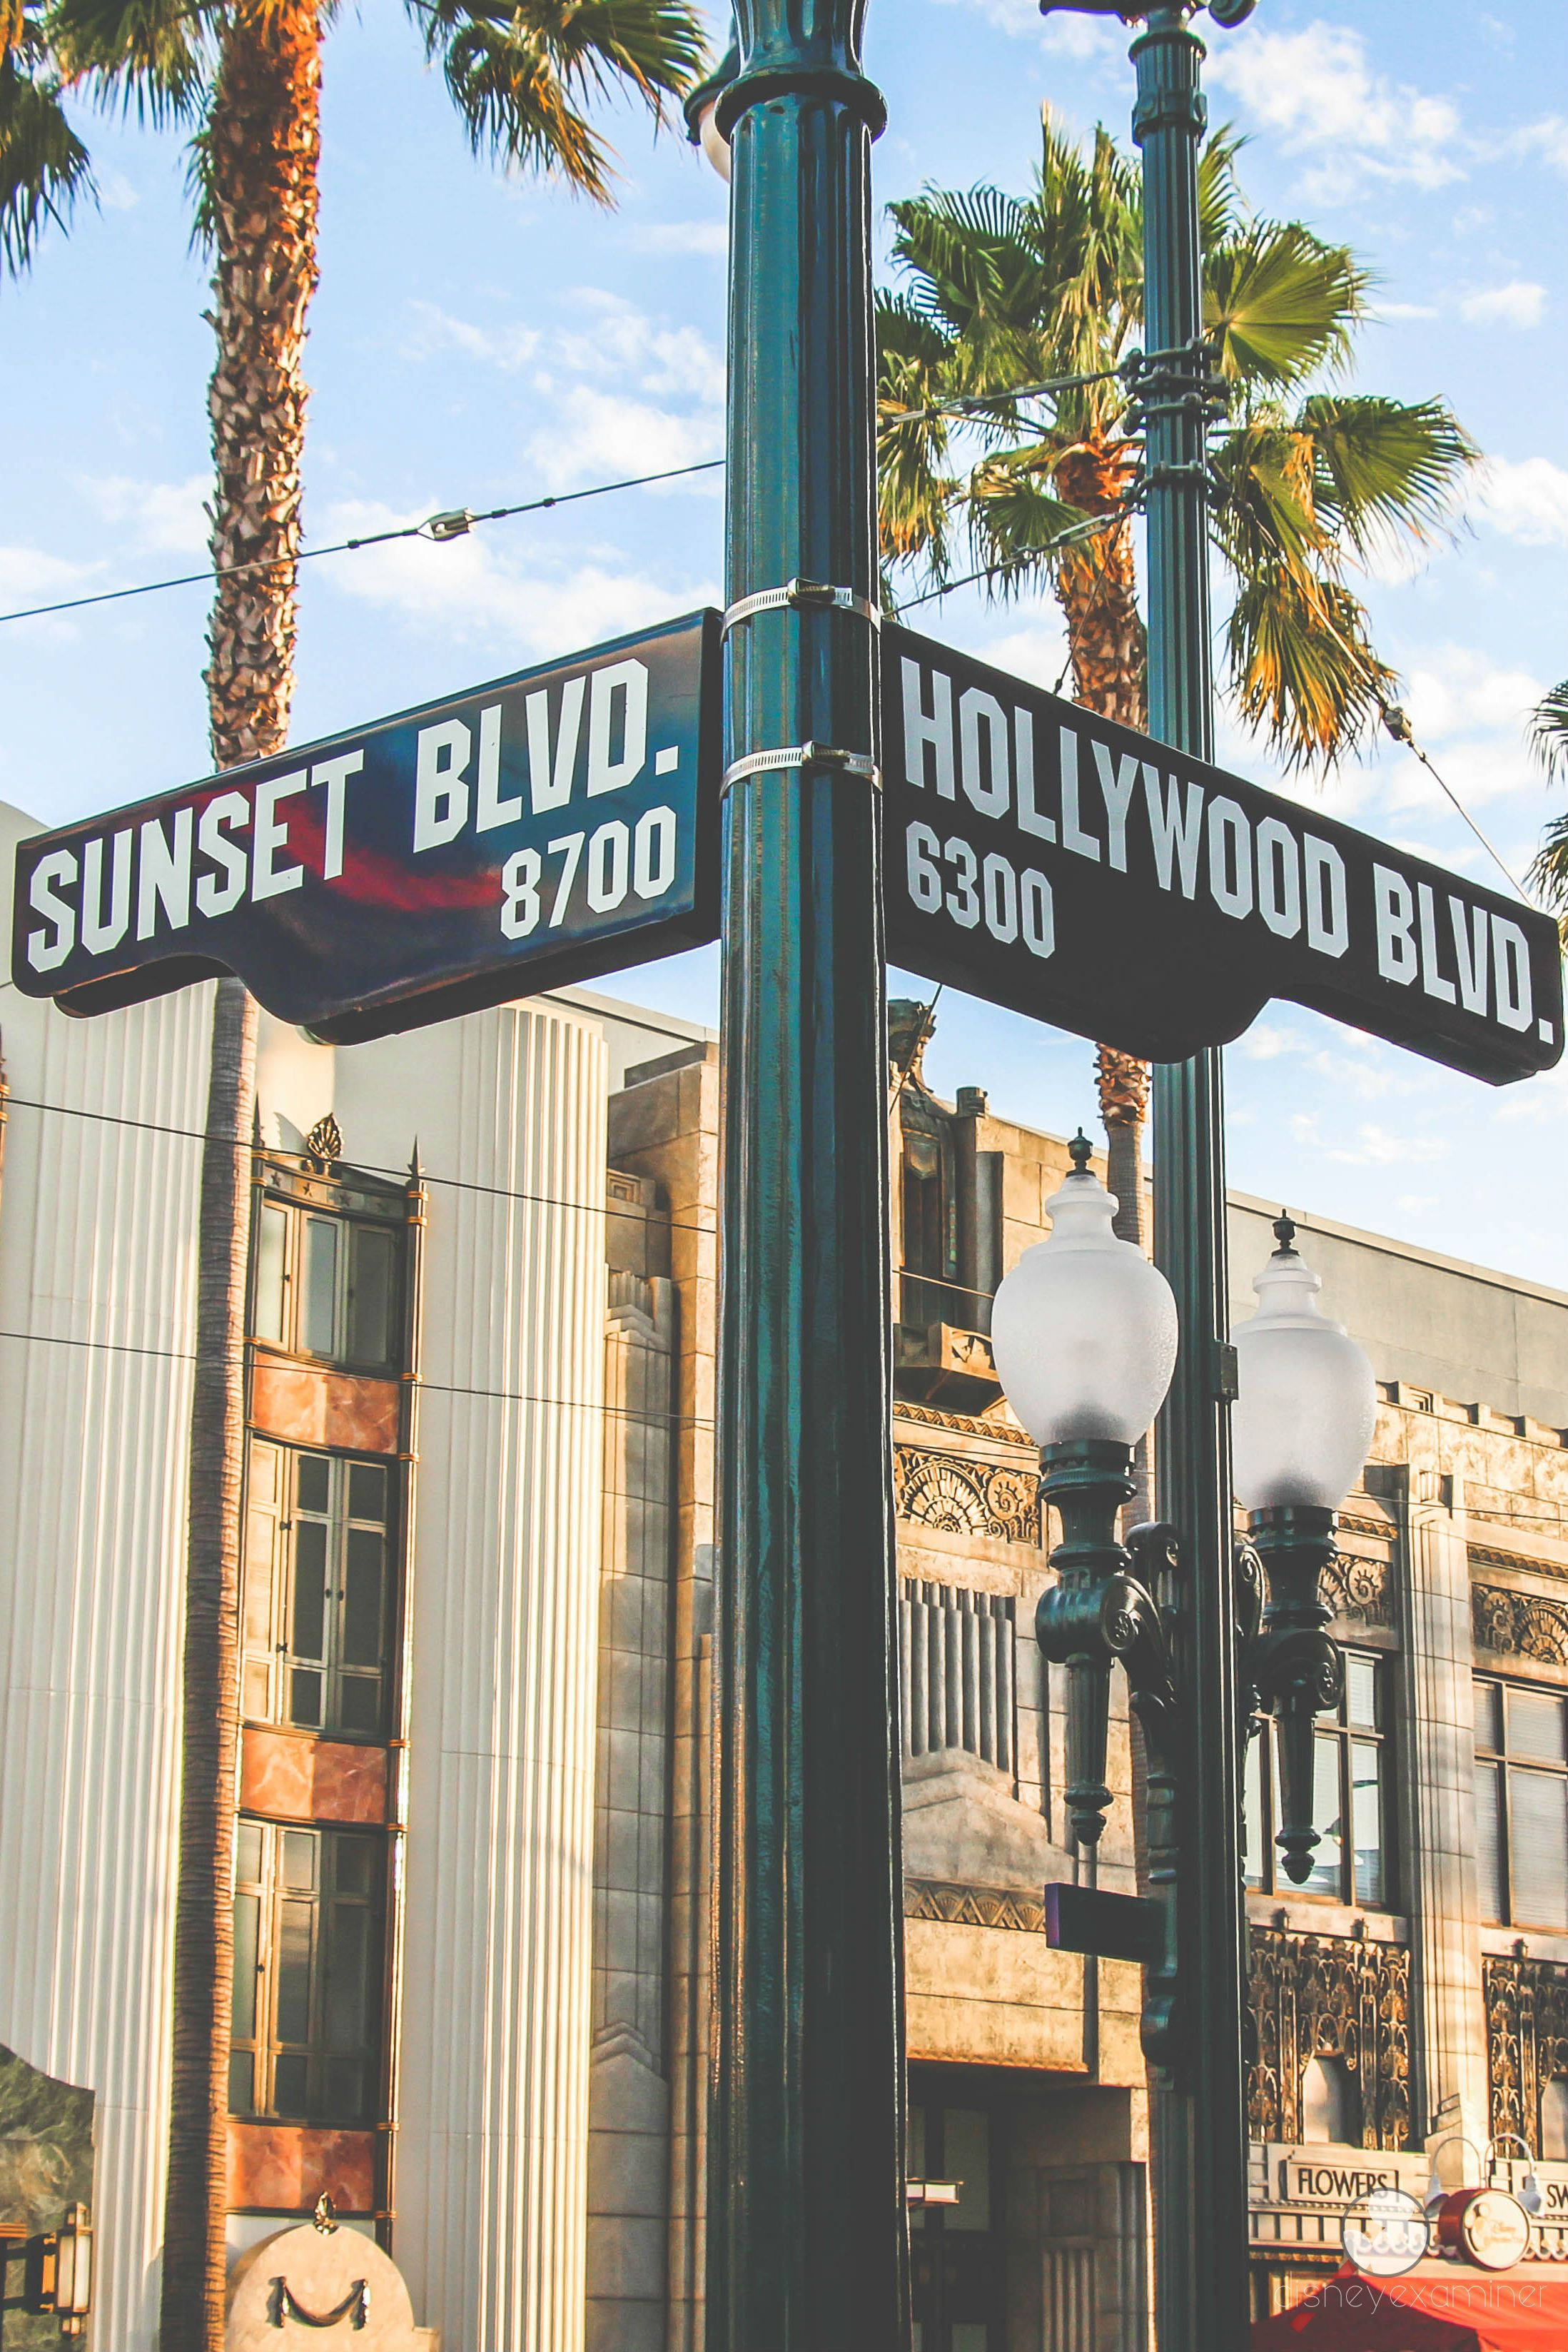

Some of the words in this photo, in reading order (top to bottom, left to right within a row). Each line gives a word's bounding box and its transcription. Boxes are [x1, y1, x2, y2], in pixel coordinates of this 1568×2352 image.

[27, 749, 365, 973] SUNSET
[413, 657, 679, 853] BLVD.
[500, 805, 677, 939] 8700
[901, 657, 1350, 959] HOLLYWOOD
[1374, 862, 1554, 1045] BLVD.
[906, 821, 1056, 959] 6300
[1298, 2168, 1388, 2199] FLOWERS
